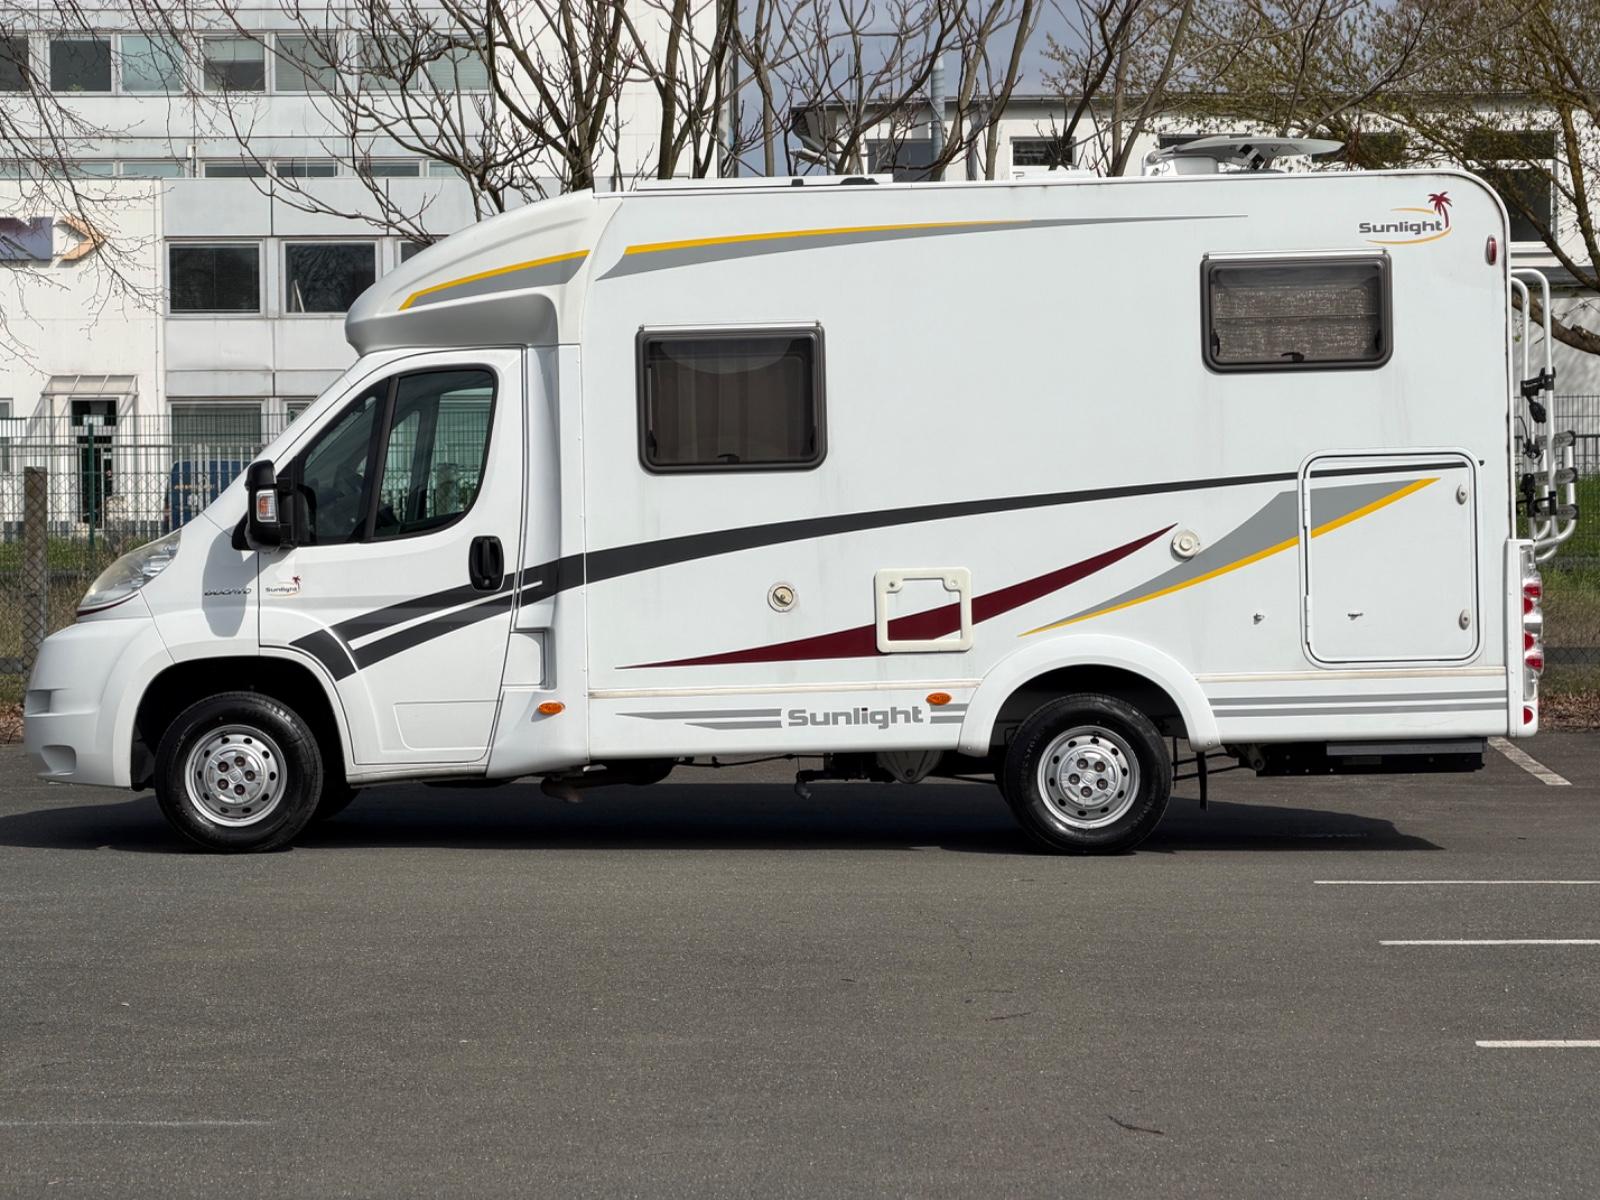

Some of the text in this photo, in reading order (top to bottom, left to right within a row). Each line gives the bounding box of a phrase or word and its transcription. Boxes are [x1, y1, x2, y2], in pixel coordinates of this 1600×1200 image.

[1358, 221, 1443, 235] Sunlight
[265, 586, 298, 594] Sunlight
[788, 706, 924, 730] Sunlight
